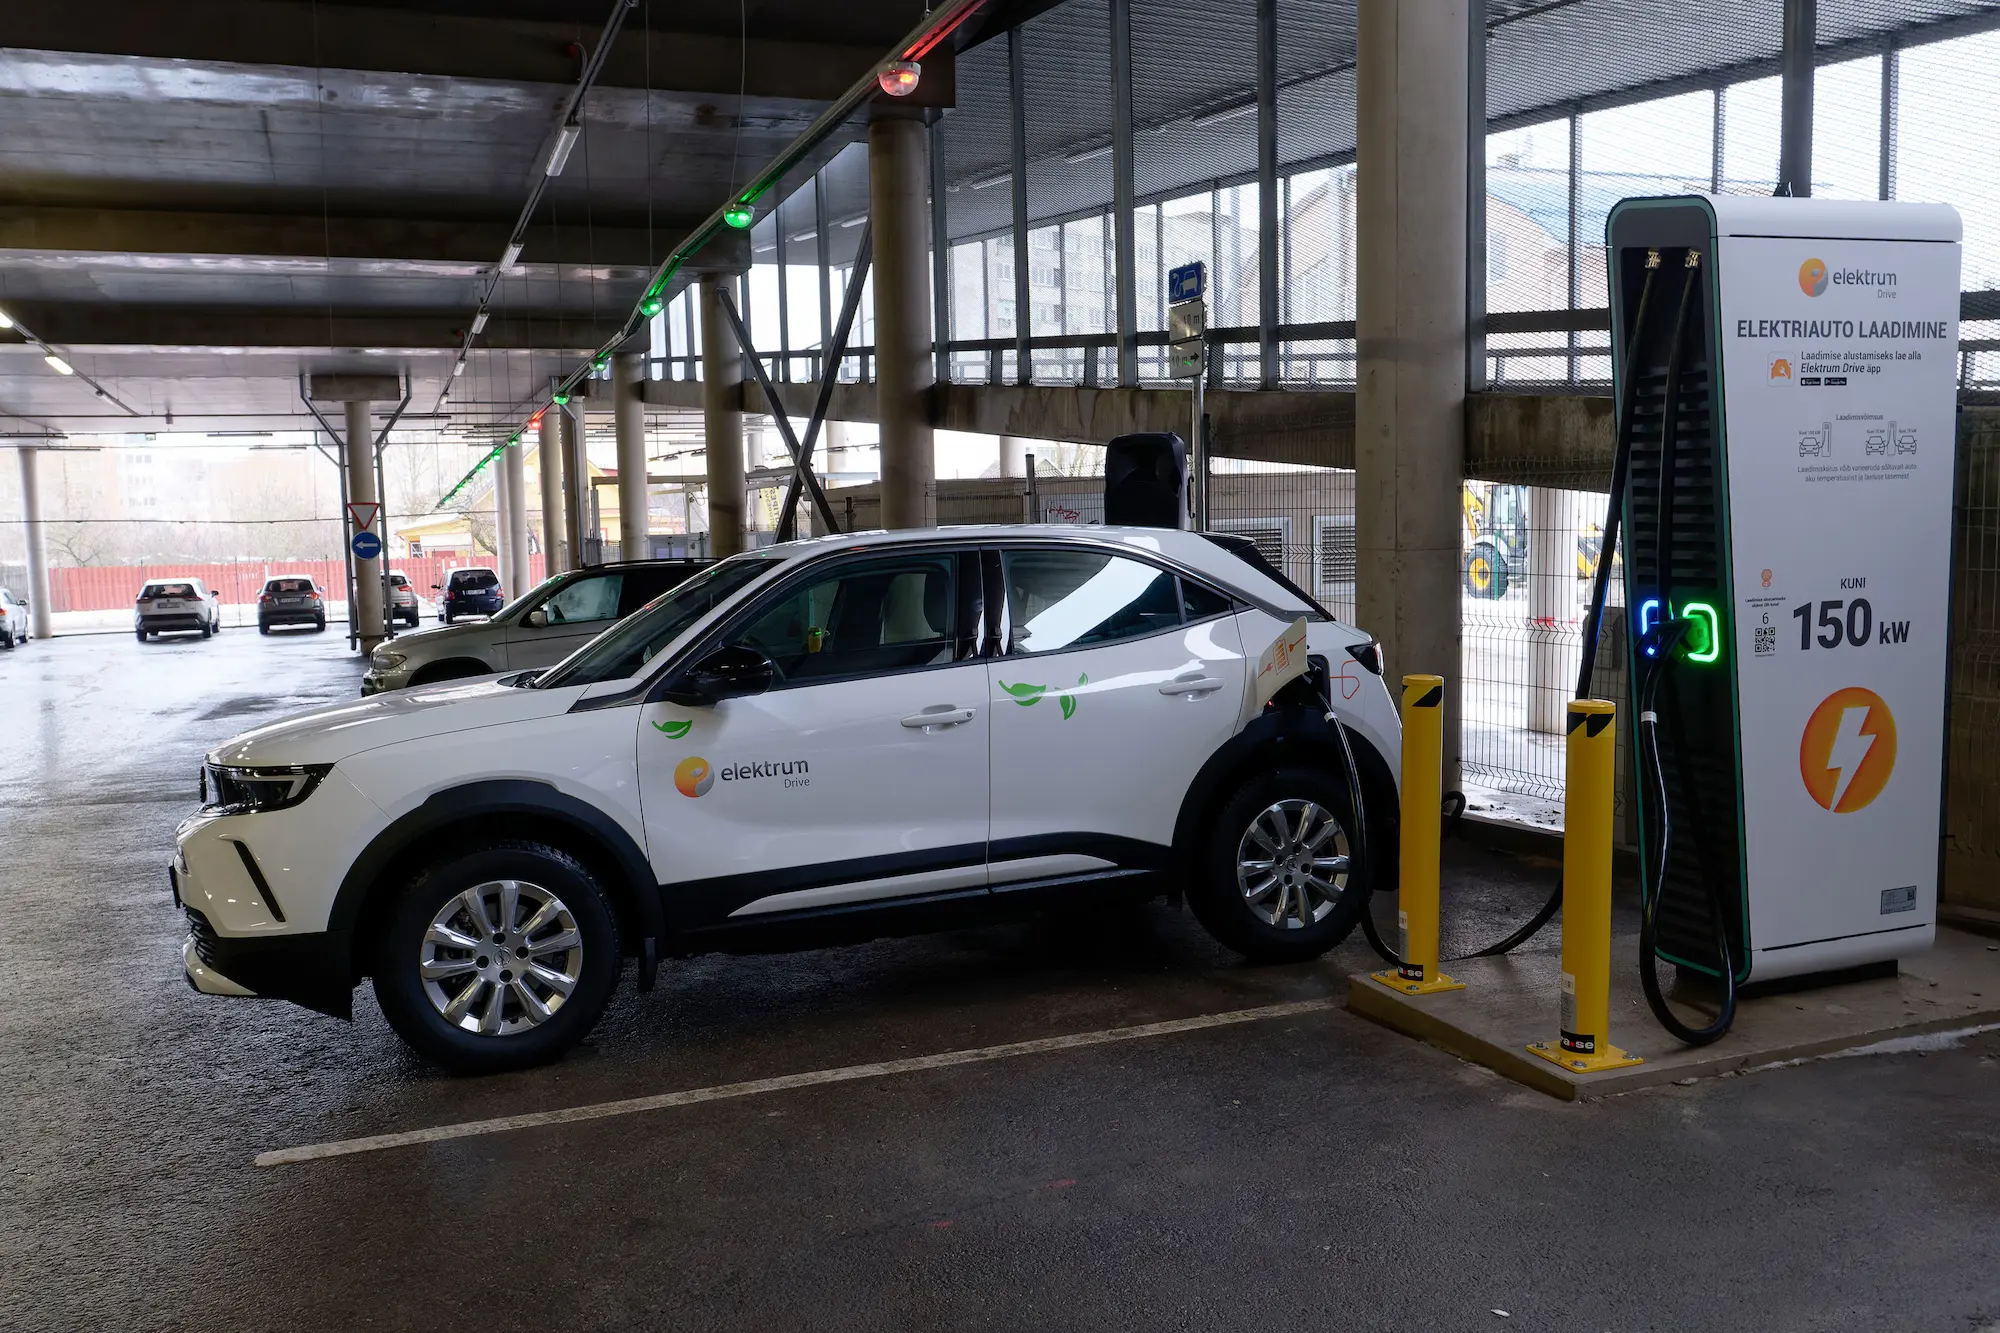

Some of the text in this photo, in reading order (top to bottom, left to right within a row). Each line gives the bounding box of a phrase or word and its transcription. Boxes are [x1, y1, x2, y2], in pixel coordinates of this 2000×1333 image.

[1833, 267, 1897, 286] elektrum
[1877, 289, 1897, 299] Drive
[1193, 314, 1200, 325] m
[1737, 320, 1948, 339] ELEKTRIAUTO LAADIMINE
[1171, 355, 1180, 367] 10
[1801, 351, 1922, 360] Laadimise alustamiseks lae alla
[1800, 363, 1881, 375] Elektrum Drive äpp
[1840, 577, 1866, 589] KUNI
[1762, 612, 1769, 625] 6
[1793, 598, 1911, 650] 150 kW
[720, 759, 809, 781] elektrum
[784, 778, 810, 789] Drive
